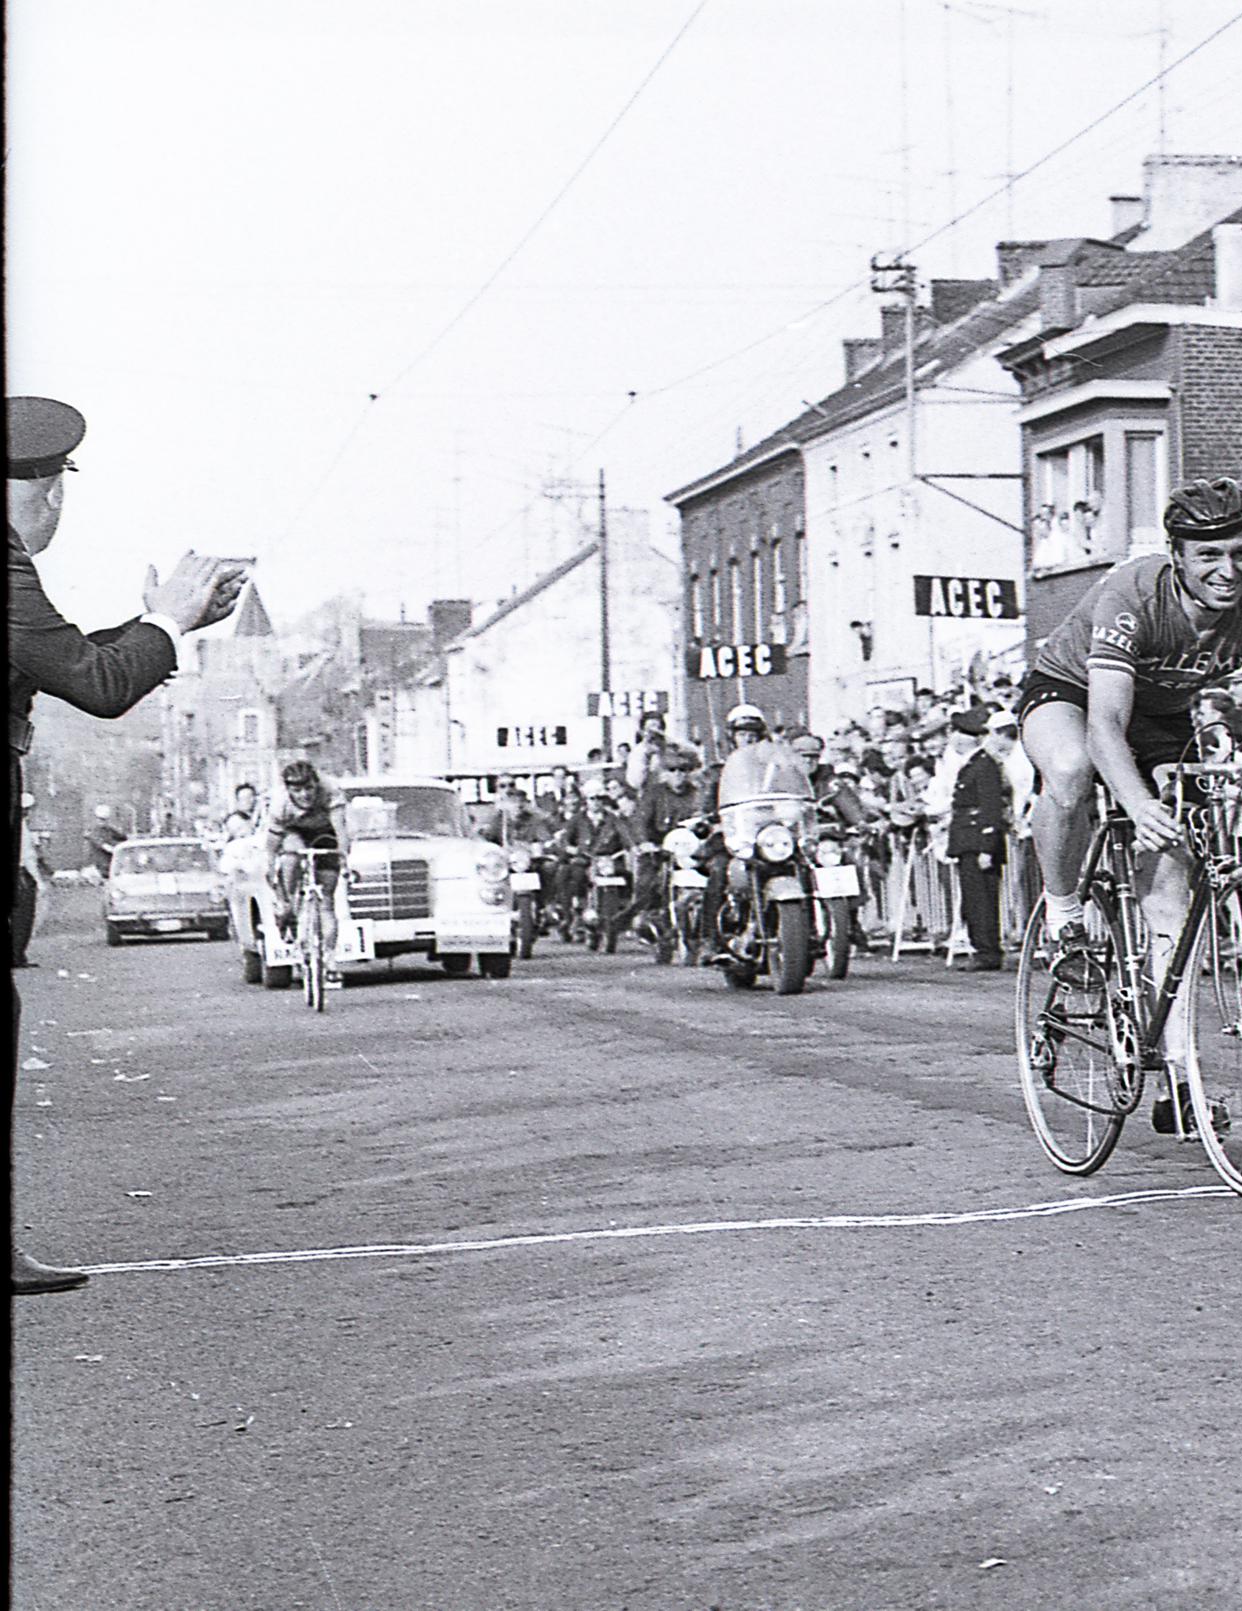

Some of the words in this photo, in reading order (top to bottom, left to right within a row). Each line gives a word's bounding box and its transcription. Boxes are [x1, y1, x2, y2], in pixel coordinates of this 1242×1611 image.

[930, 577, 1003, 618] ACEC
[699, 644, 772, 679] ACEC
[597, 691, 658, 717] ACEC
[507, 726, 560, 747] ACEC
